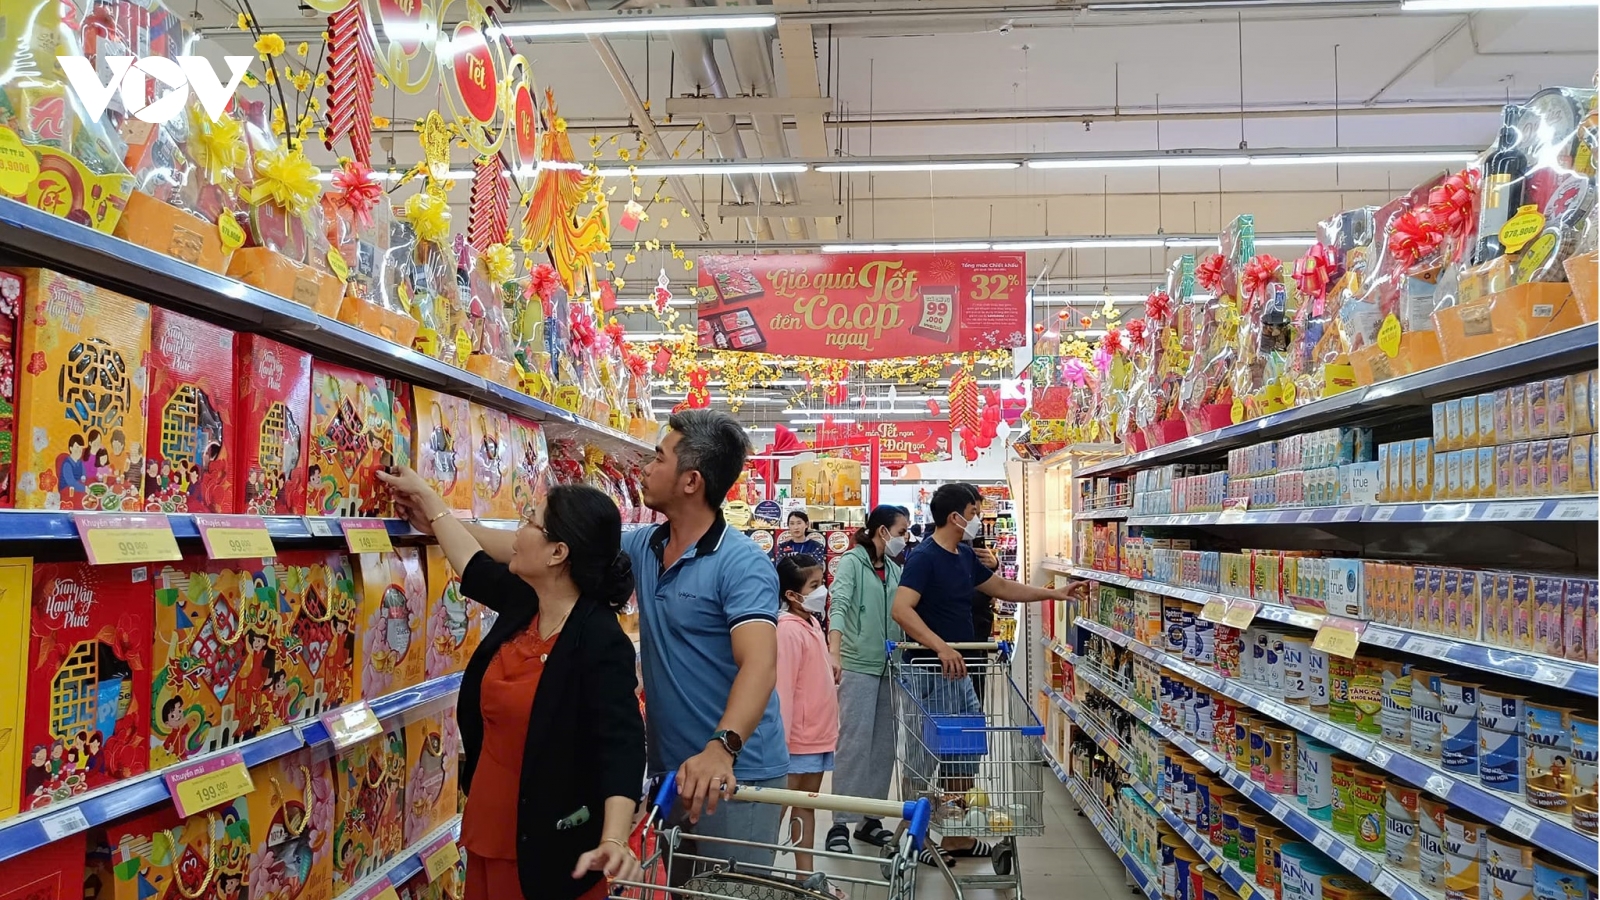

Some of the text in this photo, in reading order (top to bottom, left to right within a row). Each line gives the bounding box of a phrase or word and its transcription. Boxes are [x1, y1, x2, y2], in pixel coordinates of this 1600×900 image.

[465, 52, 486, 90] Tết
[766, 260, 918, 302] Giỏ quà Tết
[970, 273, 1020, 300] 32%
[926, 301, 948, 317] 99
[770, 295, 904, 339] đến Co.op
[826, 332, 874, 351] ngay
[878, 423, 898, 437] Tết
[1352, 477, 1368, 489] true
[52, 578, 77, 596] Sum
[1331, 582, 1343, 595] true
[1297, 680, 1304, 691] 2
[1318, 685, 1325, 697] 3
[1464, 691, 1472, 703] 3
[1502, 703, 1515, 715] 1+
[1401, 795, 1408, 804] 4
